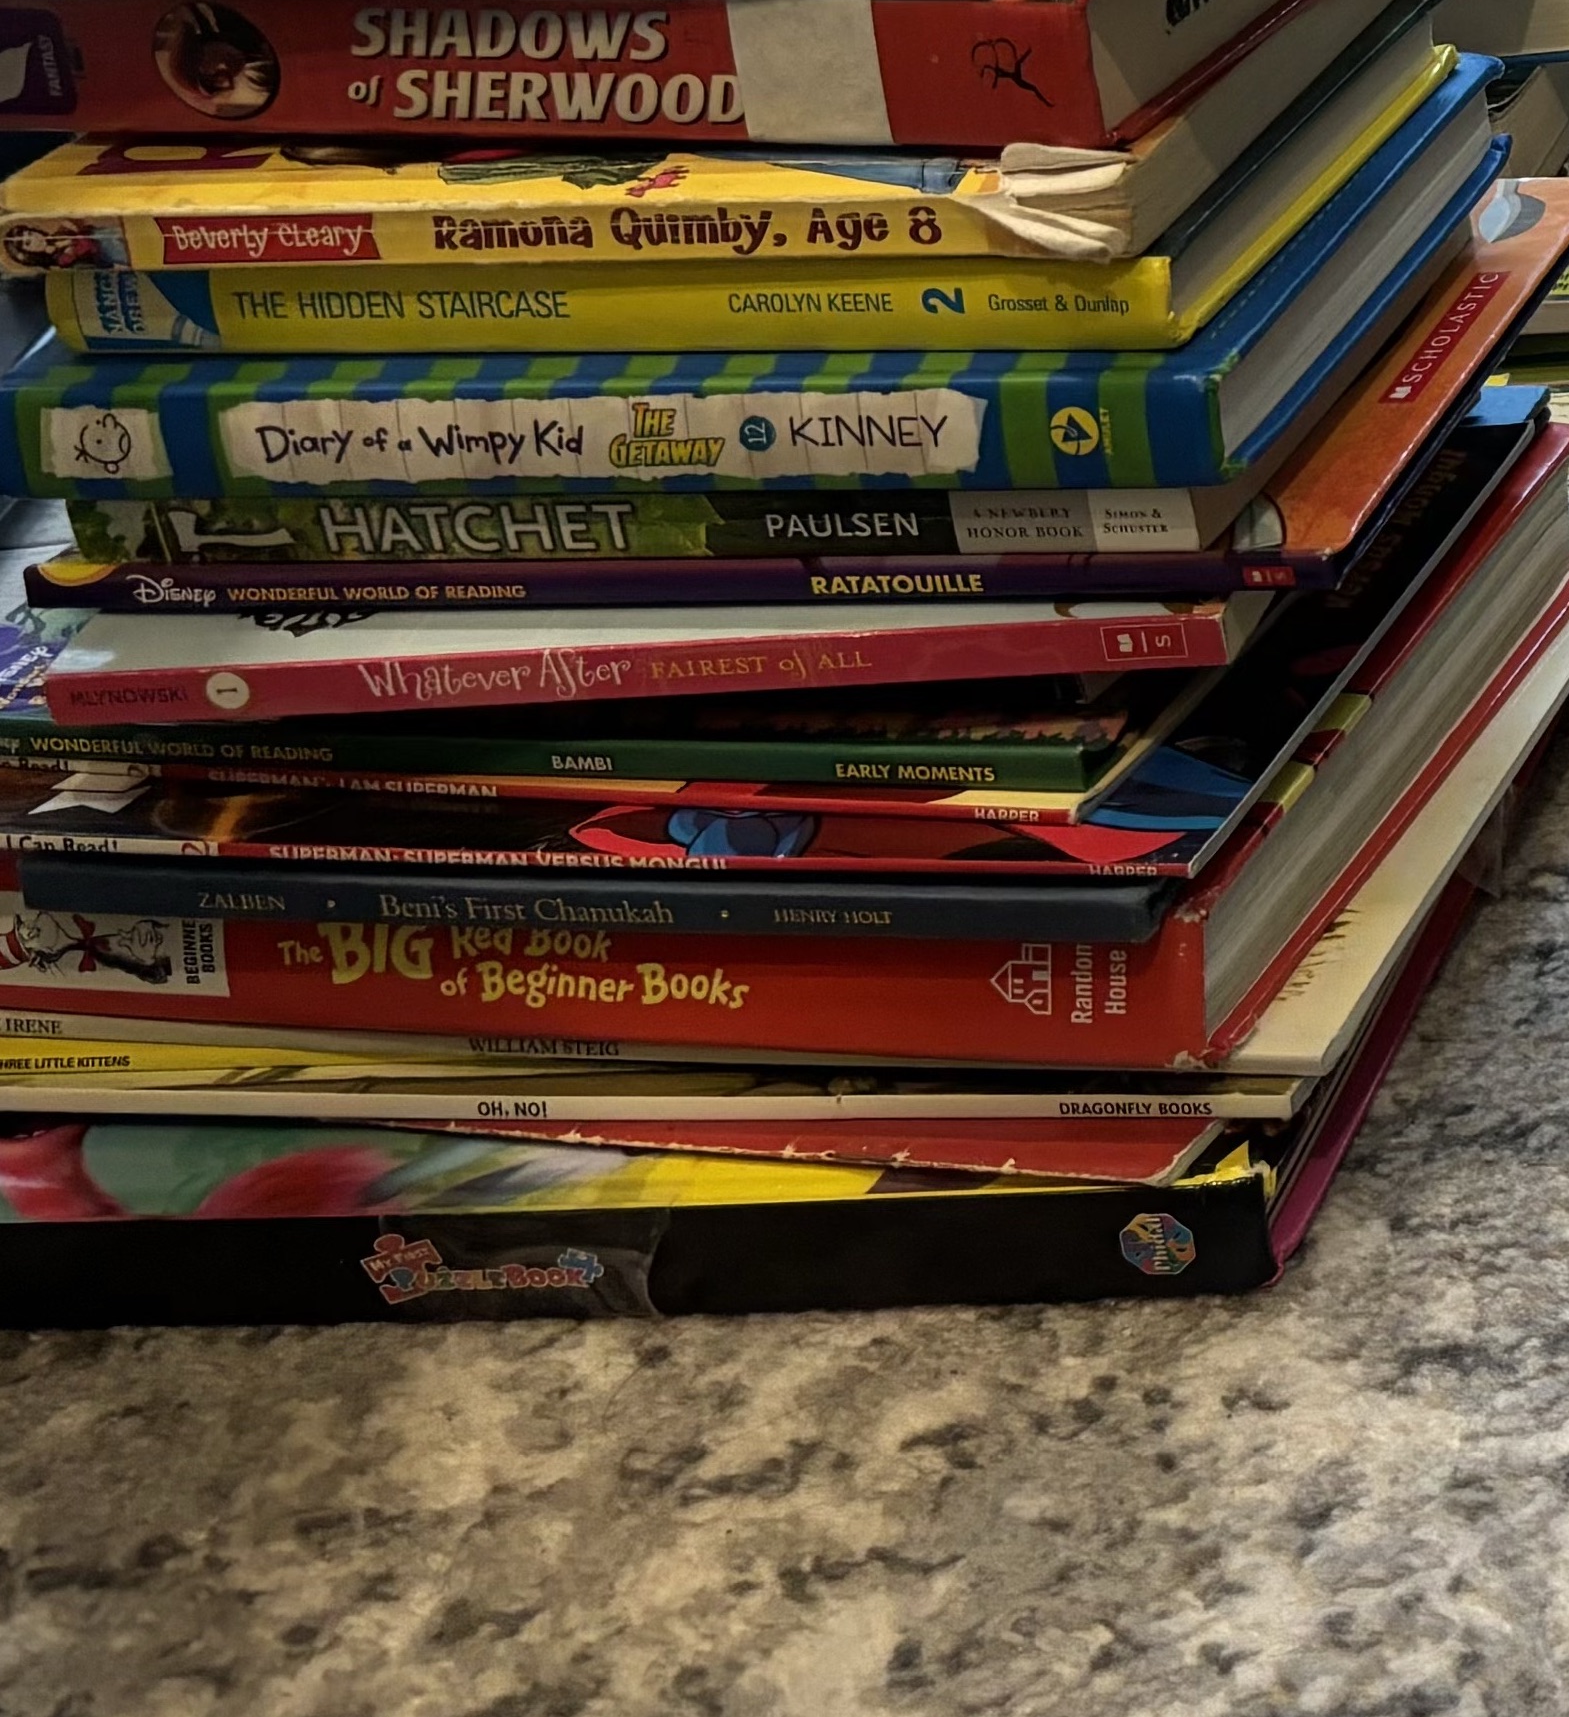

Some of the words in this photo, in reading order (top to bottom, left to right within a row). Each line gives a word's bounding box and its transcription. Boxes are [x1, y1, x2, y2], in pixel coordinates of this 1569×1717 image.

[350, 6, 669, 63] SHADOWS
[347, 74, 380, 108] of
[392, 69, 745, 126] SHERWOOD
[433, 213, 595, 251] Ramona
[609, 205, 790, 256] Quimby,
[806, 207, 890, 252] Age
[907, 204, 943, 245] 8
[232, 290, 289, 321] THE
[299, 289, 404, 320] HIDDEN
[416, 289, 571, 320] STAIRCASE
[728, 292, 822, 315] CAROLYN
[827, 292, 894, 314] KEENE
[921, 286, 967, 316] 2
[987, 293, 1049, 313] Grosset
[1053, 293, 1069, 314] &
[1073, 294, 1130, 316] Dunlap
[1403, 269, 1502, 392] SCHOLASTIC
[631, 400, 677, 441] THE
[254, 423, 355, 465] Diary
[361, 426, 391, 453] of
[396, 436, 413, 453] a
[417, 424, 526, 465] Wimpy
[532, 418, 584, 458] Kid
[608, 433, 726, 469] GETAWAY
[320, 501, 635, 555] HATCHET
[765, 510, 921, 540] PAULSEN
[227, 585, 340, 603] WONDERFUL
[343, 585, 410, 602] WORLD
[415, 585, 442, 601] OF
[443, 584, 527, 601] READING
[810, 573, 985, 597] RATATOUILLE
[357, 659, 531, 702] Whatever
[538, 647, 632, 700] After
[551, 754, 614, 772] BAMBI
[835, 762, 891, 780] EARLY
[897, 763, 996, 782] MOMENTS
[277, 939, 325, 965] The
[317, 921, 434, 985] BIG
[440, 970, 469, 998] of
[475, 960, 634, 1010] Beginner
[637, 962, 750, 1012] Books
[477, 1100, 511, 1120] OH,
[513, 1100, 549, 1119] NO!
[1059, 1100, 1156, 1116] DRAGONFLY
[1157, 1100, 1213, 1116] BOOKS
